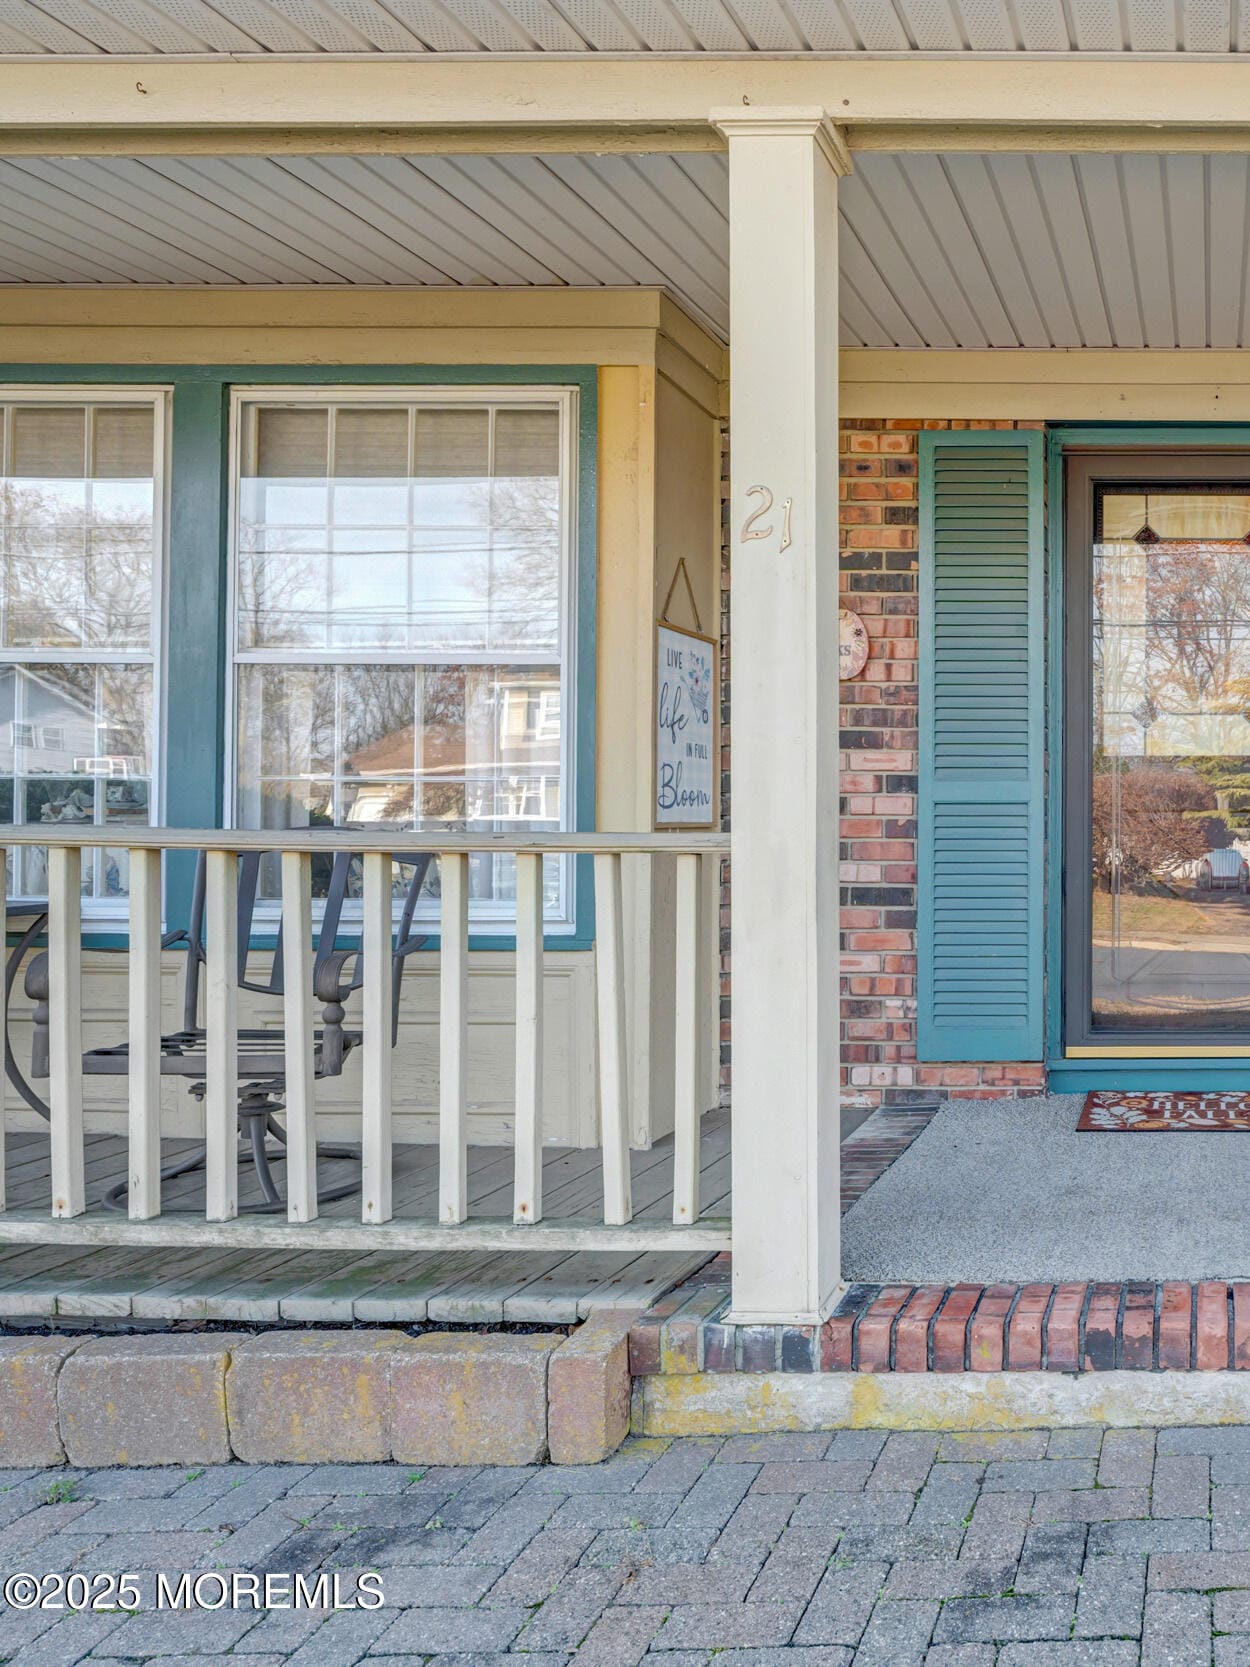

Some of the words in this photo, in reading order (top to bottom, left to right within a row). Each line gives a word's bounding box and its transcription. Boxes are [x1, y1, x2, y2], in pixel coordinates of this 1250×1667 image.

[740, 484, 793, 555] 21
[667, 648, 683, 670] LIVE
[659, 682, 690, 744] life
[685, 742, 693, 758] IN
[694, 743, 708, 760] FULL
[658, 760, 710, 809] Bloom
[1162, 1110, 1248, 1119] FALL
